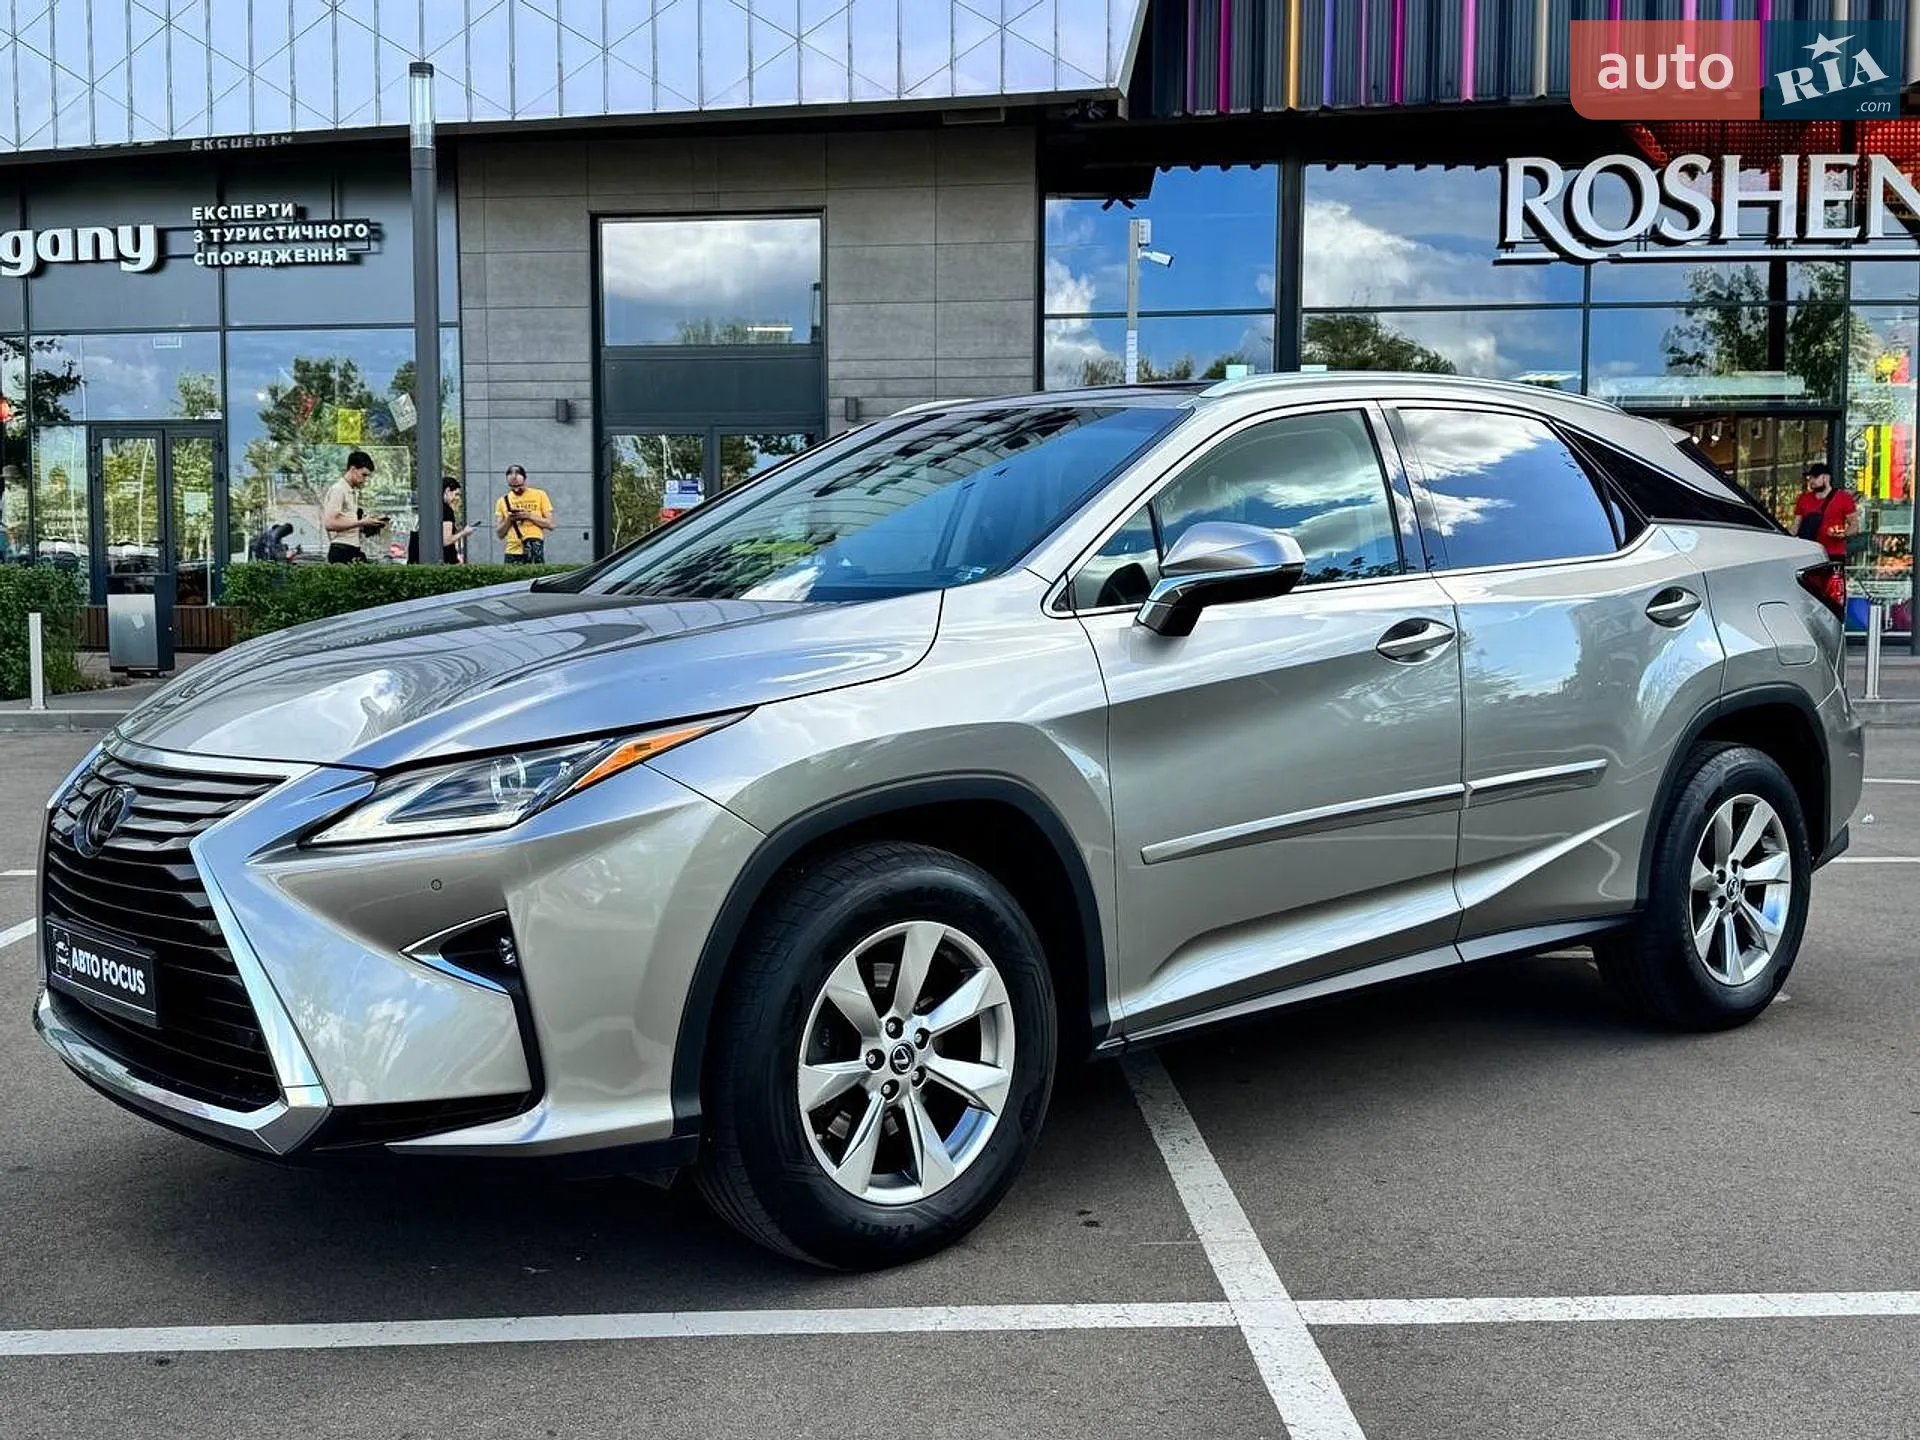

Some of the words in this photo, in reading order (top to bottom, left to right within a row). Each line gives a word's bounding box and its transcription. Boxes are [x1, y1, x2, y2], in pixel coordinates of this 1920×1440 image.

[191, 202, 294, 221] ЕКСПЕРТИ
[1504, 153, 1920, 260] ROSHEN
[210, 223, 369, 242] ТУРИСТИЧНОГО
[0, 224, 156, 276] gany
[193, 248, 349, 267] СПОРЯДЖЕННЯ
[71, 946, 101, 979] АВТО
[101, 957, 146, 995] FOCUS
